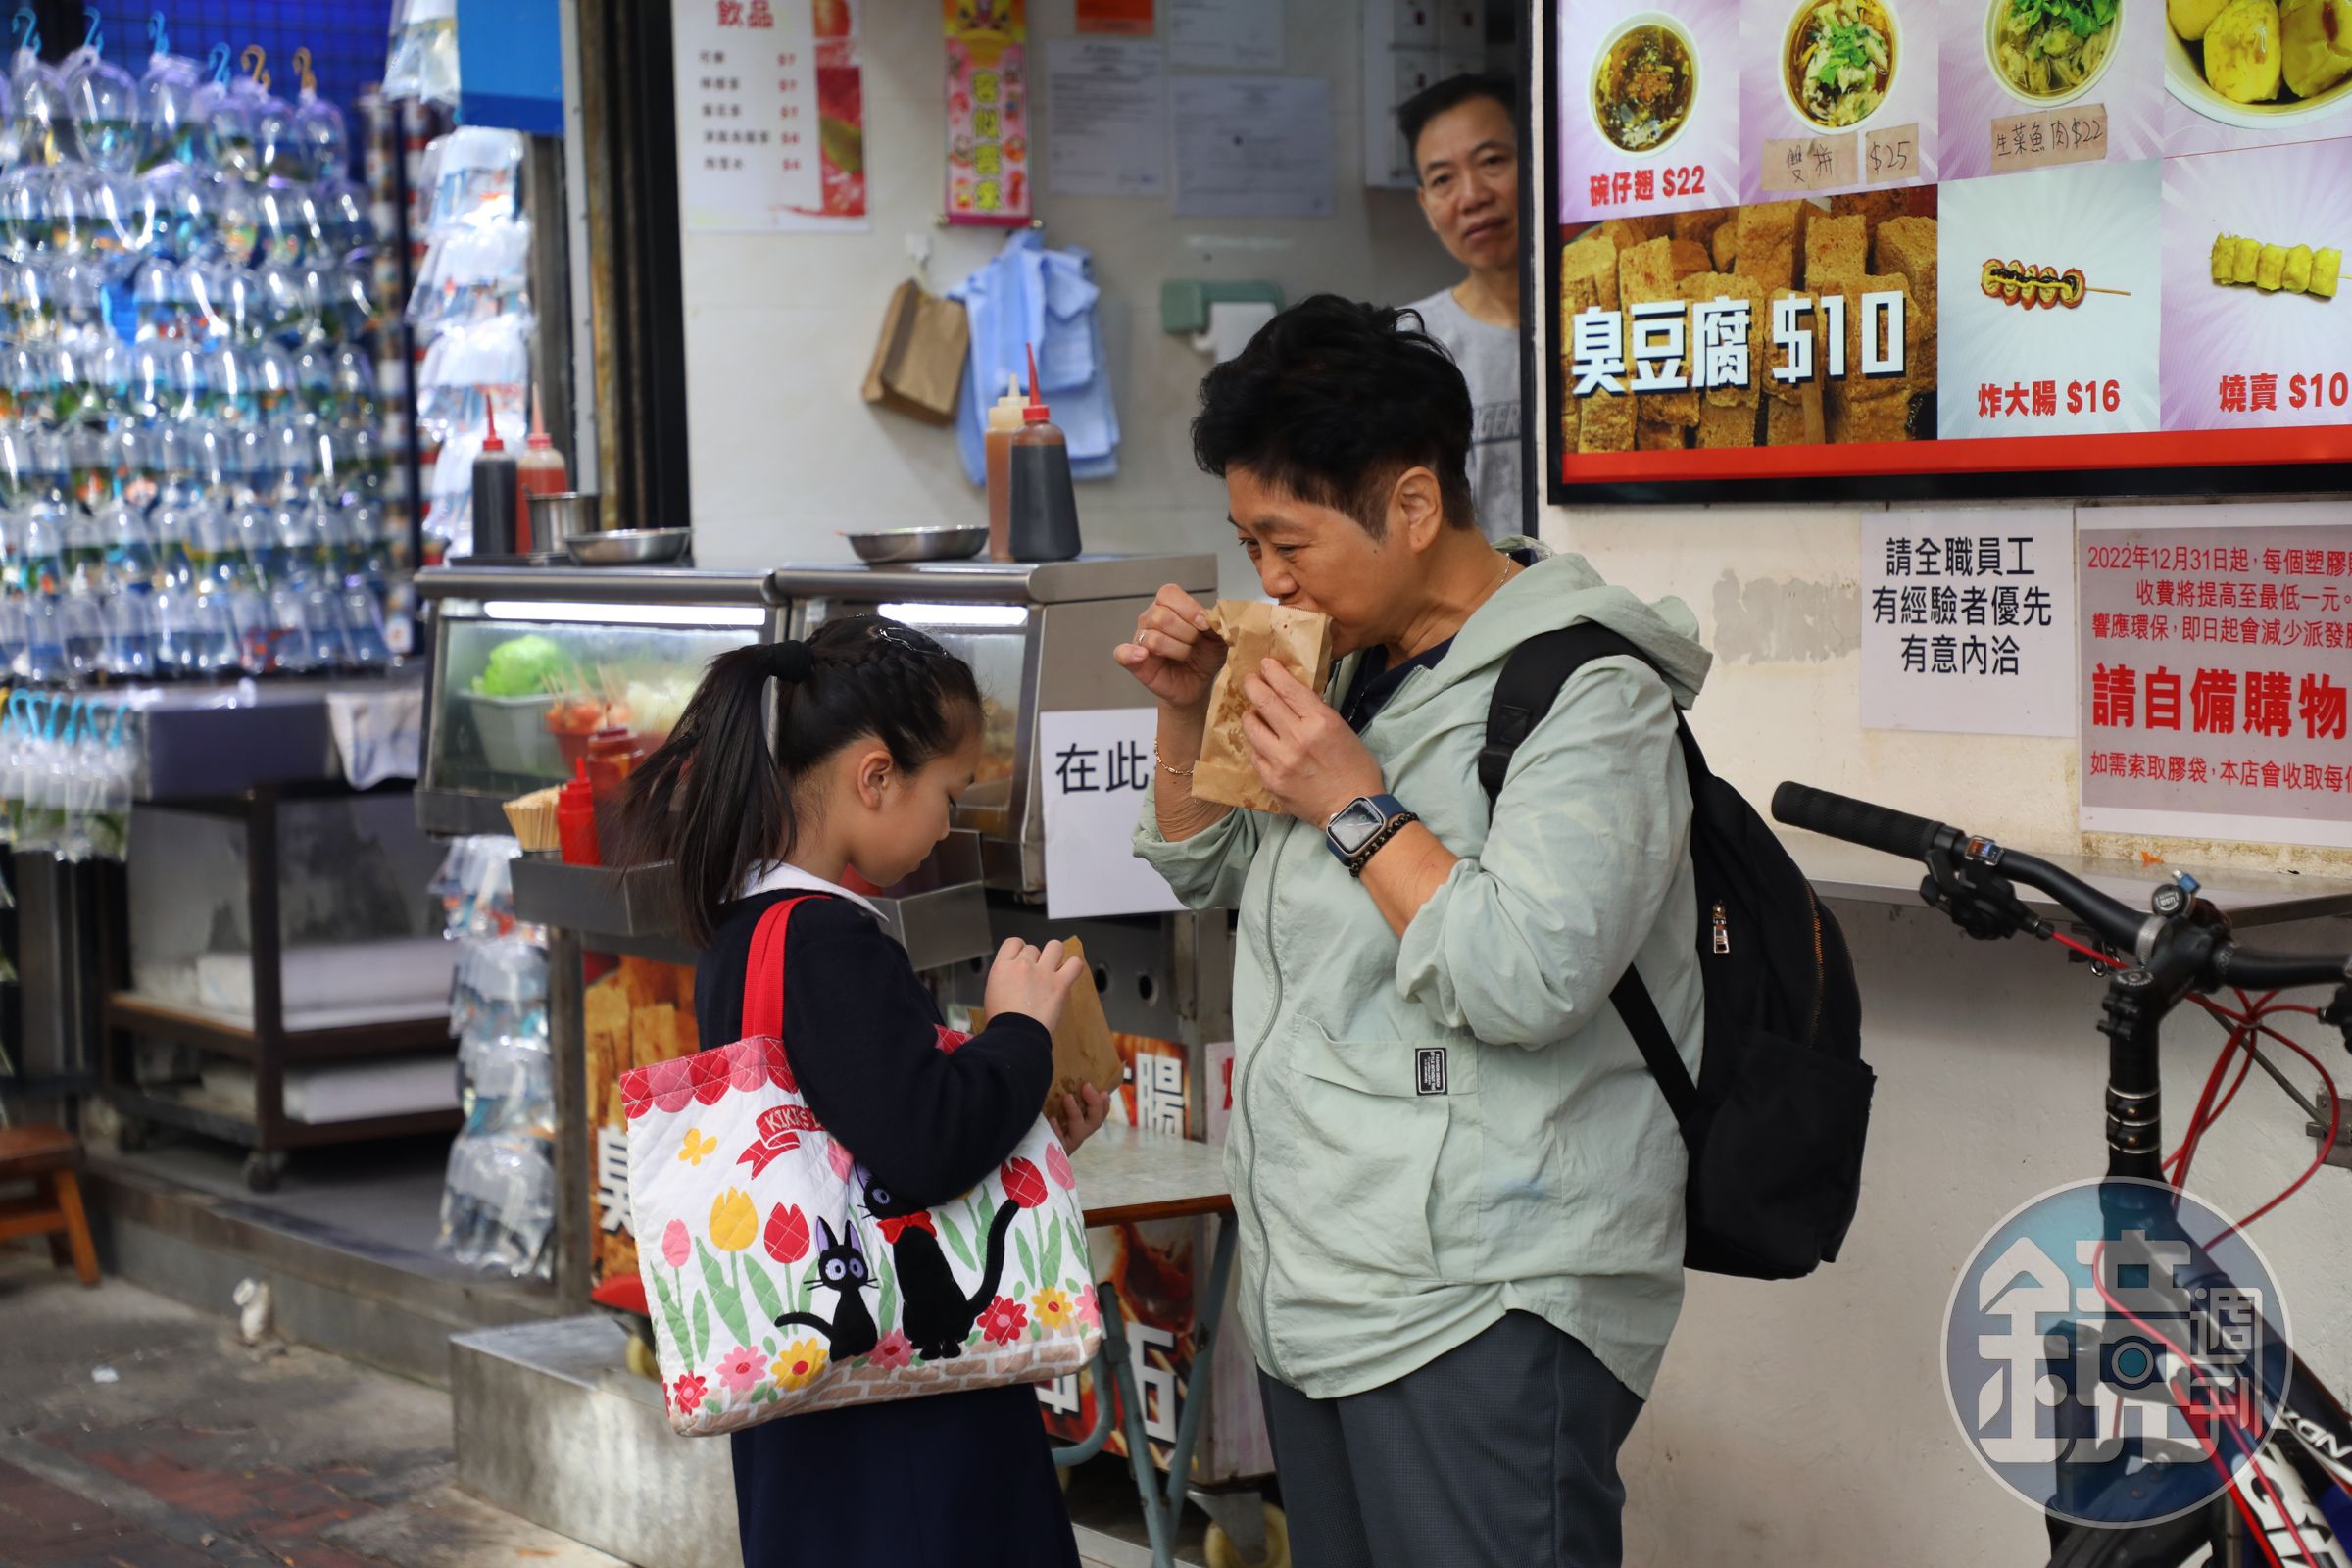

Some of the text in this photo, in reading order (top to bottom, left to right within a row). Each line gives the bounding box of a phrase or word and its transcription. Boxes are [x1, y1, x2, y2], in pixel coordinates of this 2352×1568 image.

[717, 0, 775, 28] 飲品
[1869, 140, 1911, 172] $25
[1590, 165, 1706, 207] 碗仔翅 $22
[1572, 290, 1905, 395] 臭豆腐 $10
[1978, 379, 2121, 418] 炸大腸 $16
[2219, 371, 2349, 413] 燒賣 $10
[1886, 536, 2036, 578] 請全職員工
[1872, 584, 2052, 626] 有經驗者優先
[1901, 633, 2020, 676] 有意內洽
[2091, 662, 2348, 741] 請自備購物
[1055, 740, 1149, 795] 在此
